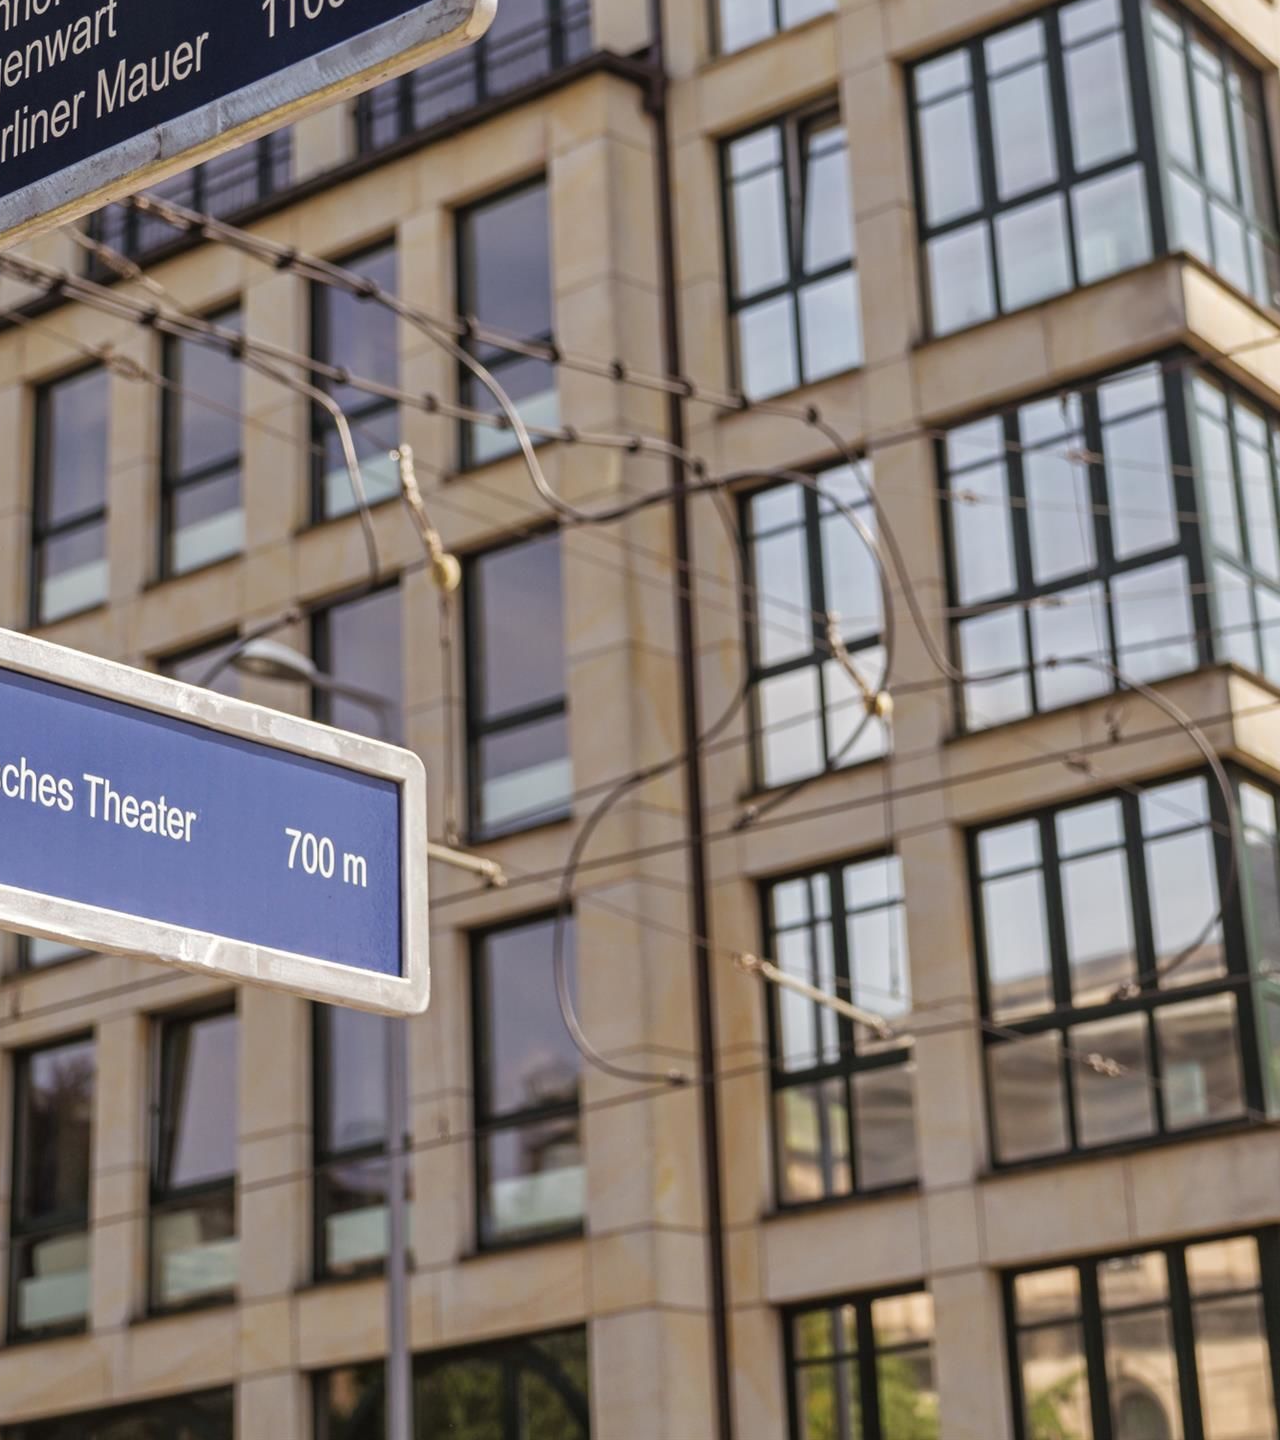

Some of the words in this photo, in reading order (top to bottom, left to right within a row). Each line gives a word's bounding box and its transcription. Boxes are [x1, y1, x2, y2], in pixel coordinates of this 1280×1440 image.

[96, 32, 209, 118] Mauer
[82, 773, 197, 843] Theater
[285, 827, 335, 879] 700
[343, 852, 367, 888] m
